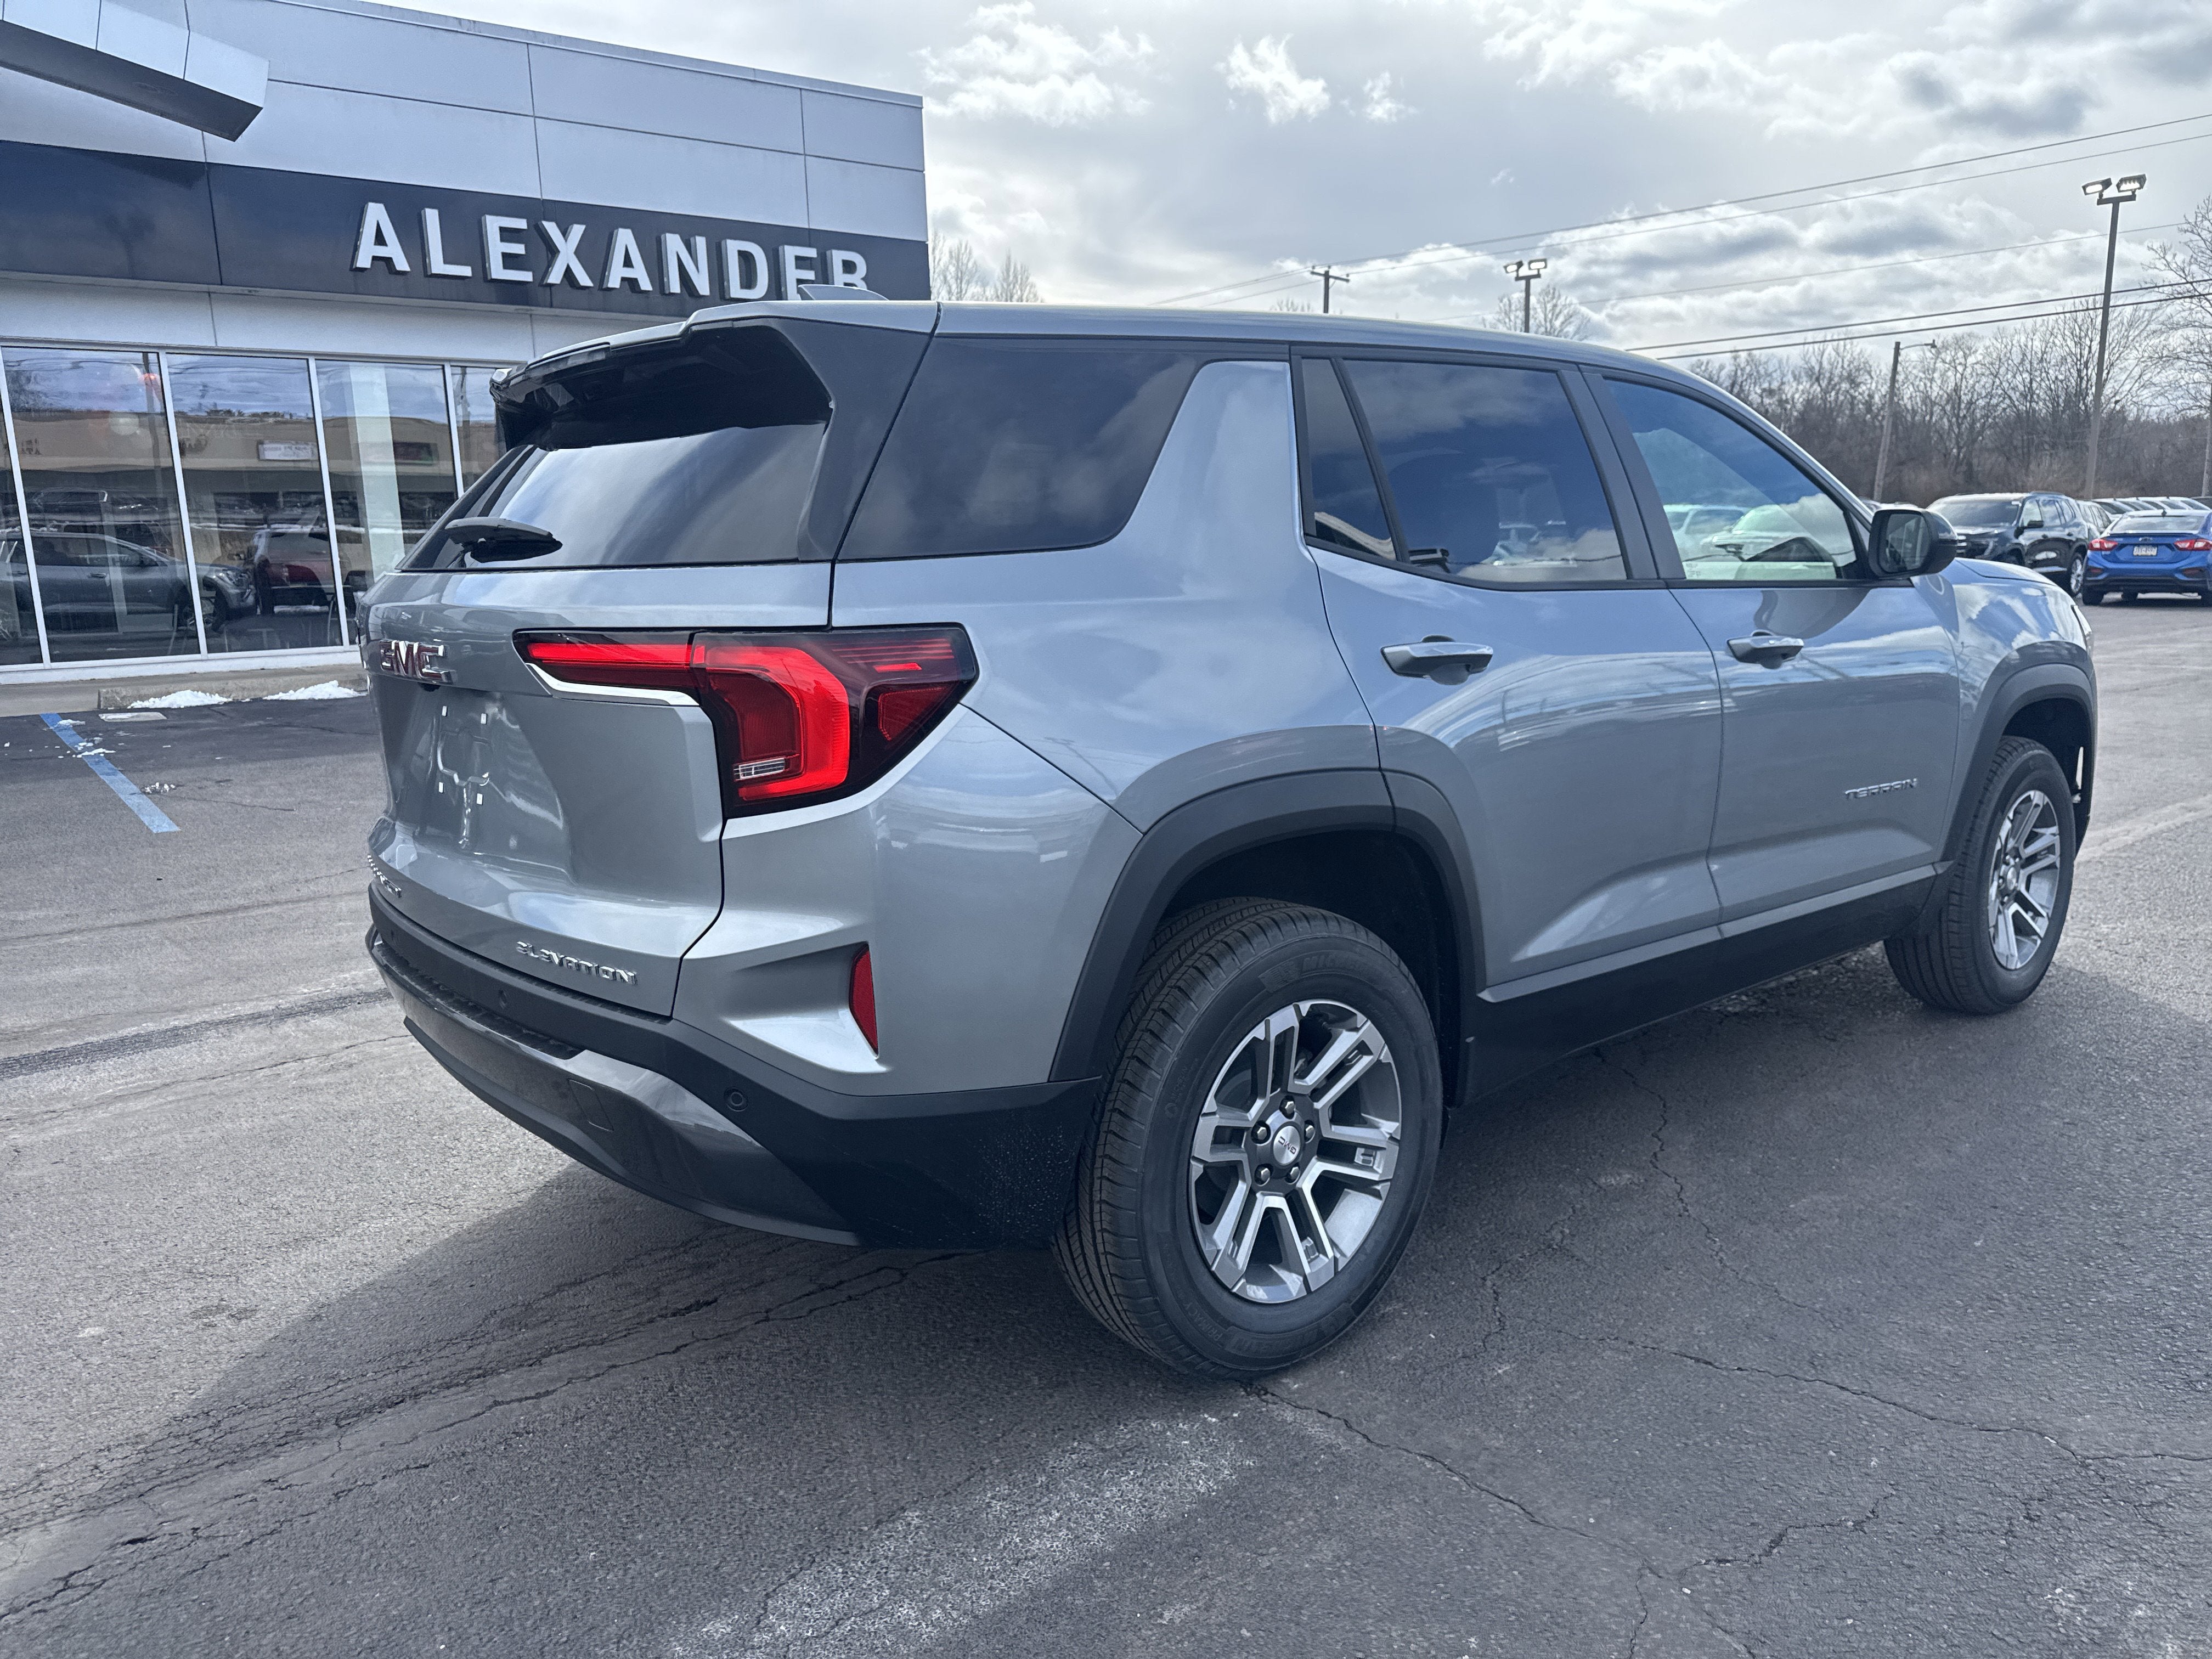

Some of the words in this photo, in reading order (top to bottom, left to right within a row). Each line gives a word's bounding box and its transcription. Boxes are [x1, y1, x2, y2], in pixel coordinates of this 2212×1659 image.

[353, 202, 868, 301] ALEXANDER
[380, 640, 450, 683] GMC
[1845, 778, 1917, 798] TERRAIN
[516, 941, 639, 985] ELEVATION
[1278, 1136, 1297, 1155] GMC
[1183, 1302, 1223, 1341] PRIMACY
